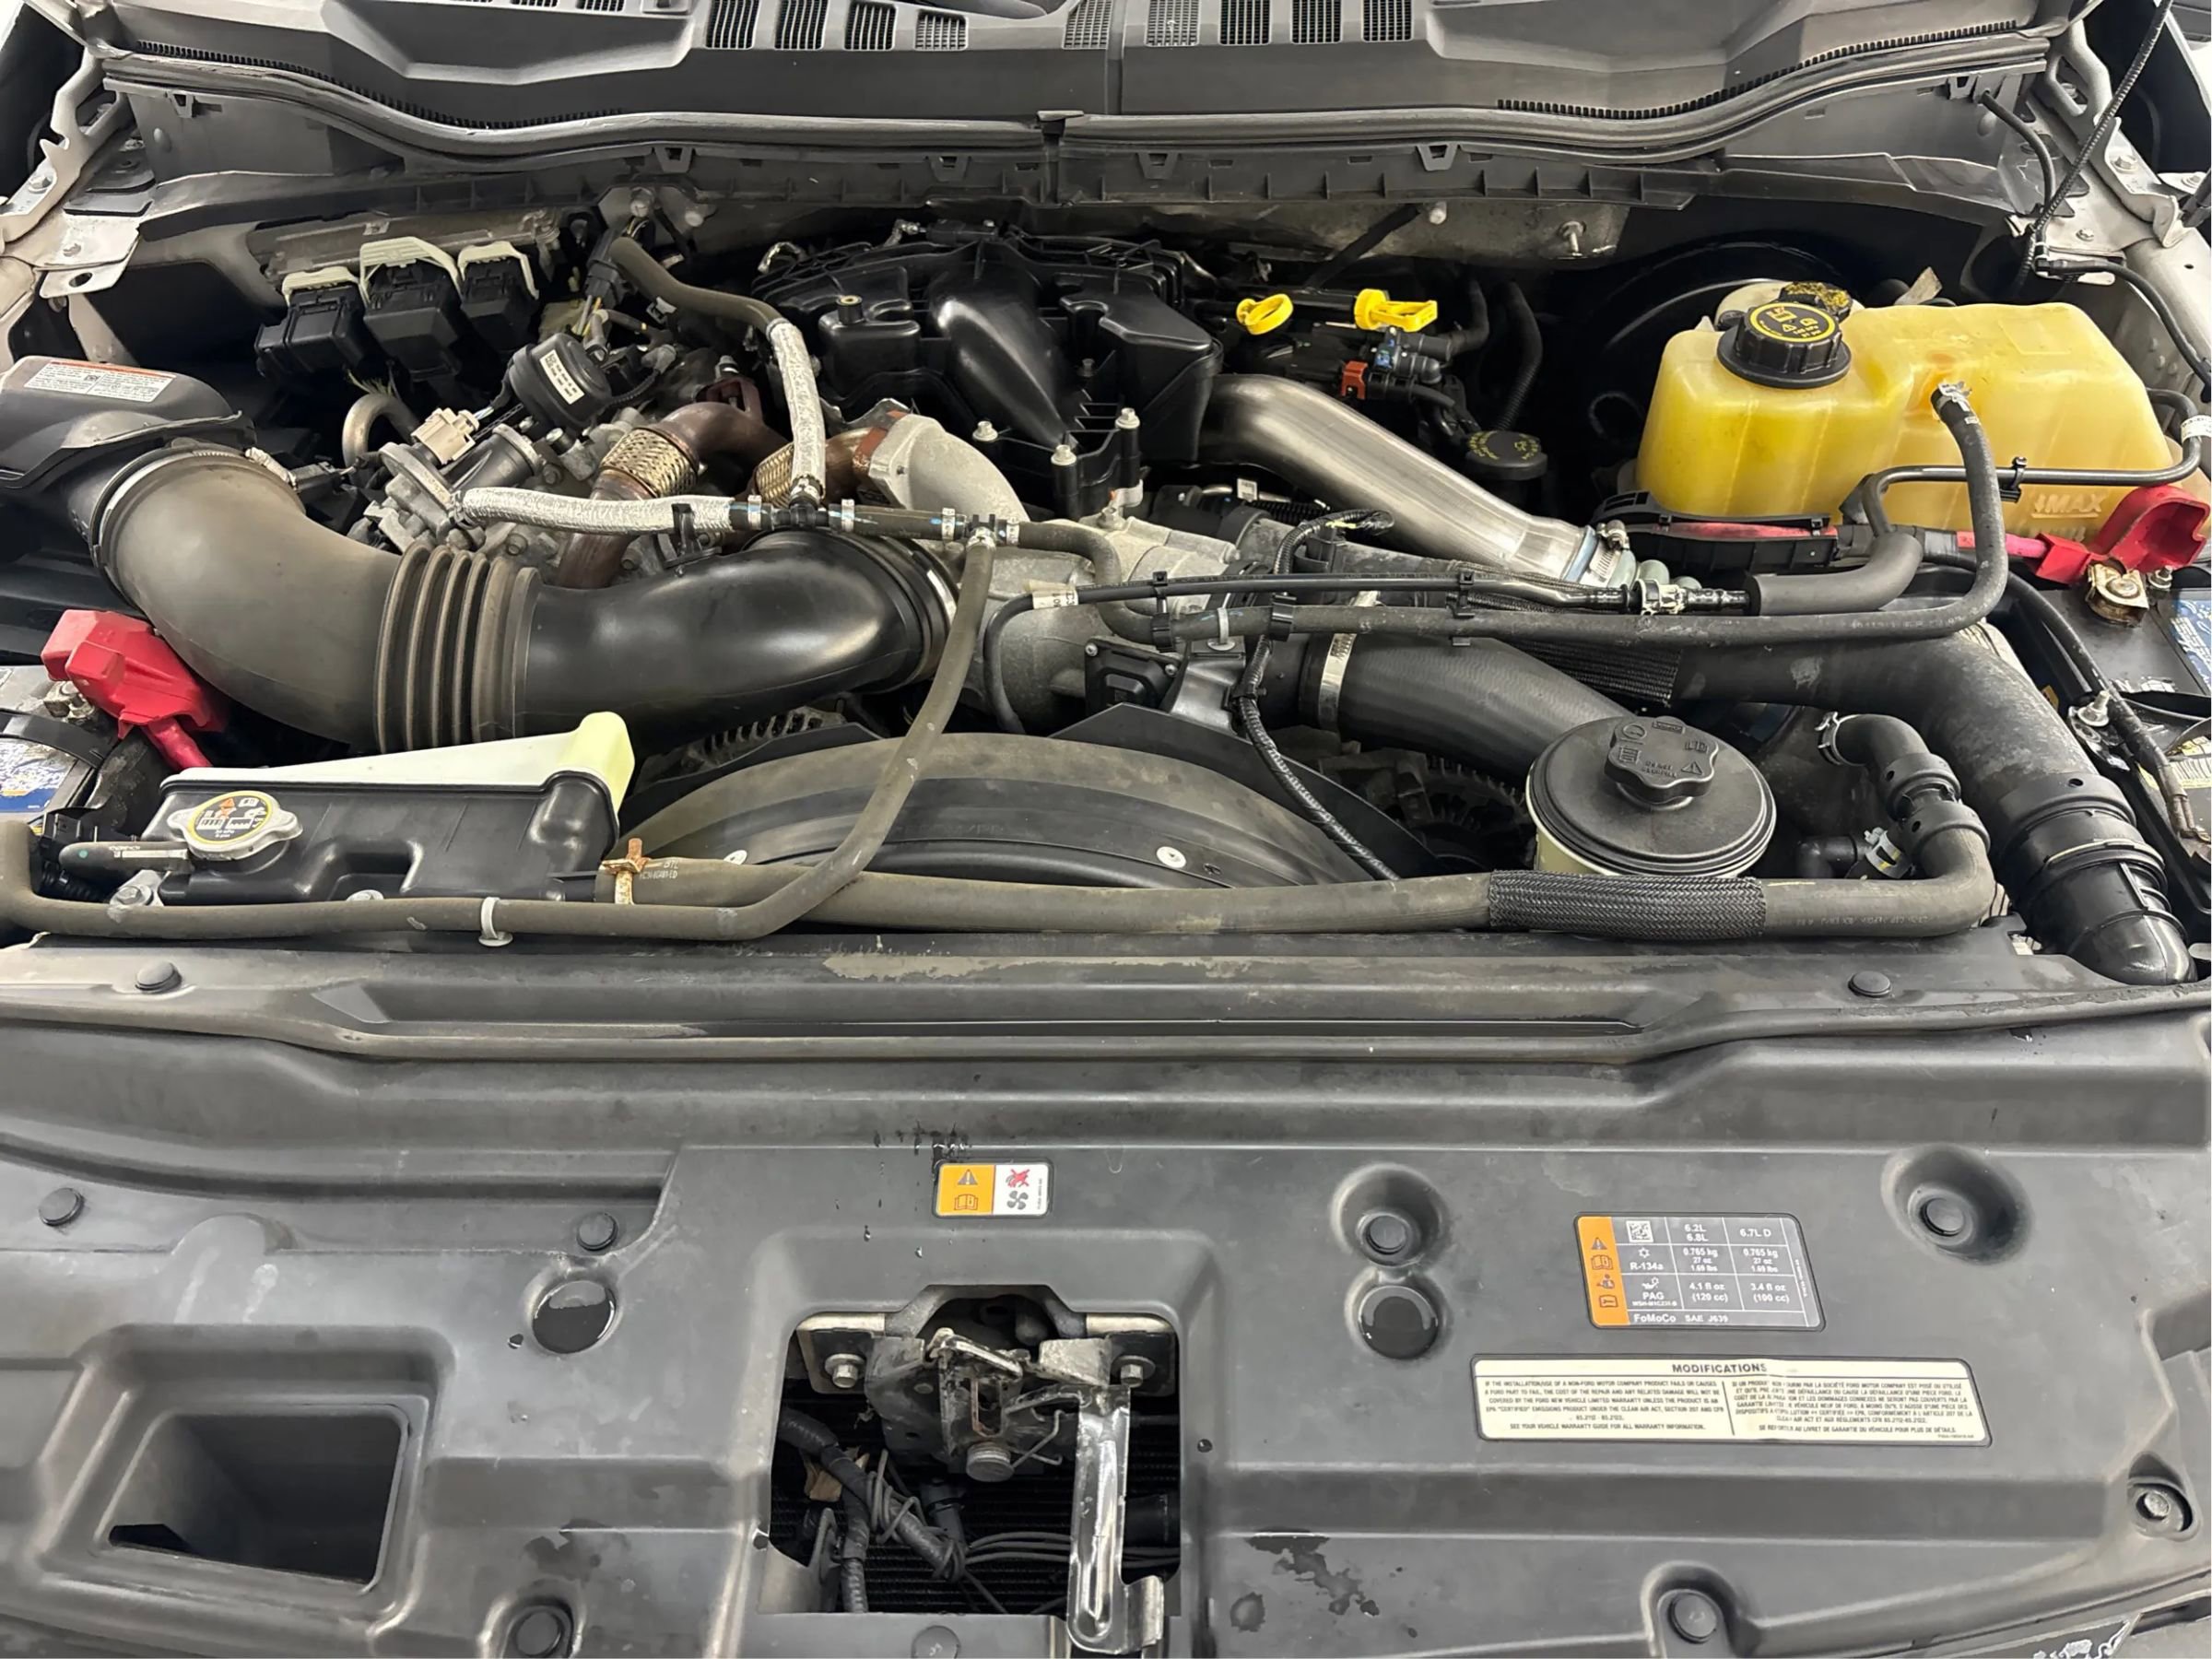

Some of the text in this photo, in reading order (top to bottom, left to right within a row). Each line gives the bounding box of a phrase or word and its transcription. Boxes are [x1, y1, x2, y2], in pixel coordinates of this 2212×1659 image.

[2045, 494, 2105, 513] MAX
[1684, 1224, 1706, 1232] 6.2L
[1740, 1228, 1771, 1237] 6.7L D
[1686, 1233, 1708, 1241] 6.8L
[1707, 1248, 1718, 1258] kg
[1767, 1248, 1779, 1258] kg
[1630, 1262, 1664, 1270] R-134a
[1642, 1292, 1664, 1300] PAG
[1713, 1293, 1728, 1303] cc)
[1775, 1294, 1790, 1304] cc)
[1634, 1314, 1676, 1322] FoMoCo
[1685, 1314, 1704, 1322] SAE
[1672, 1364, 1767, 1373] MODIFICATIONS
